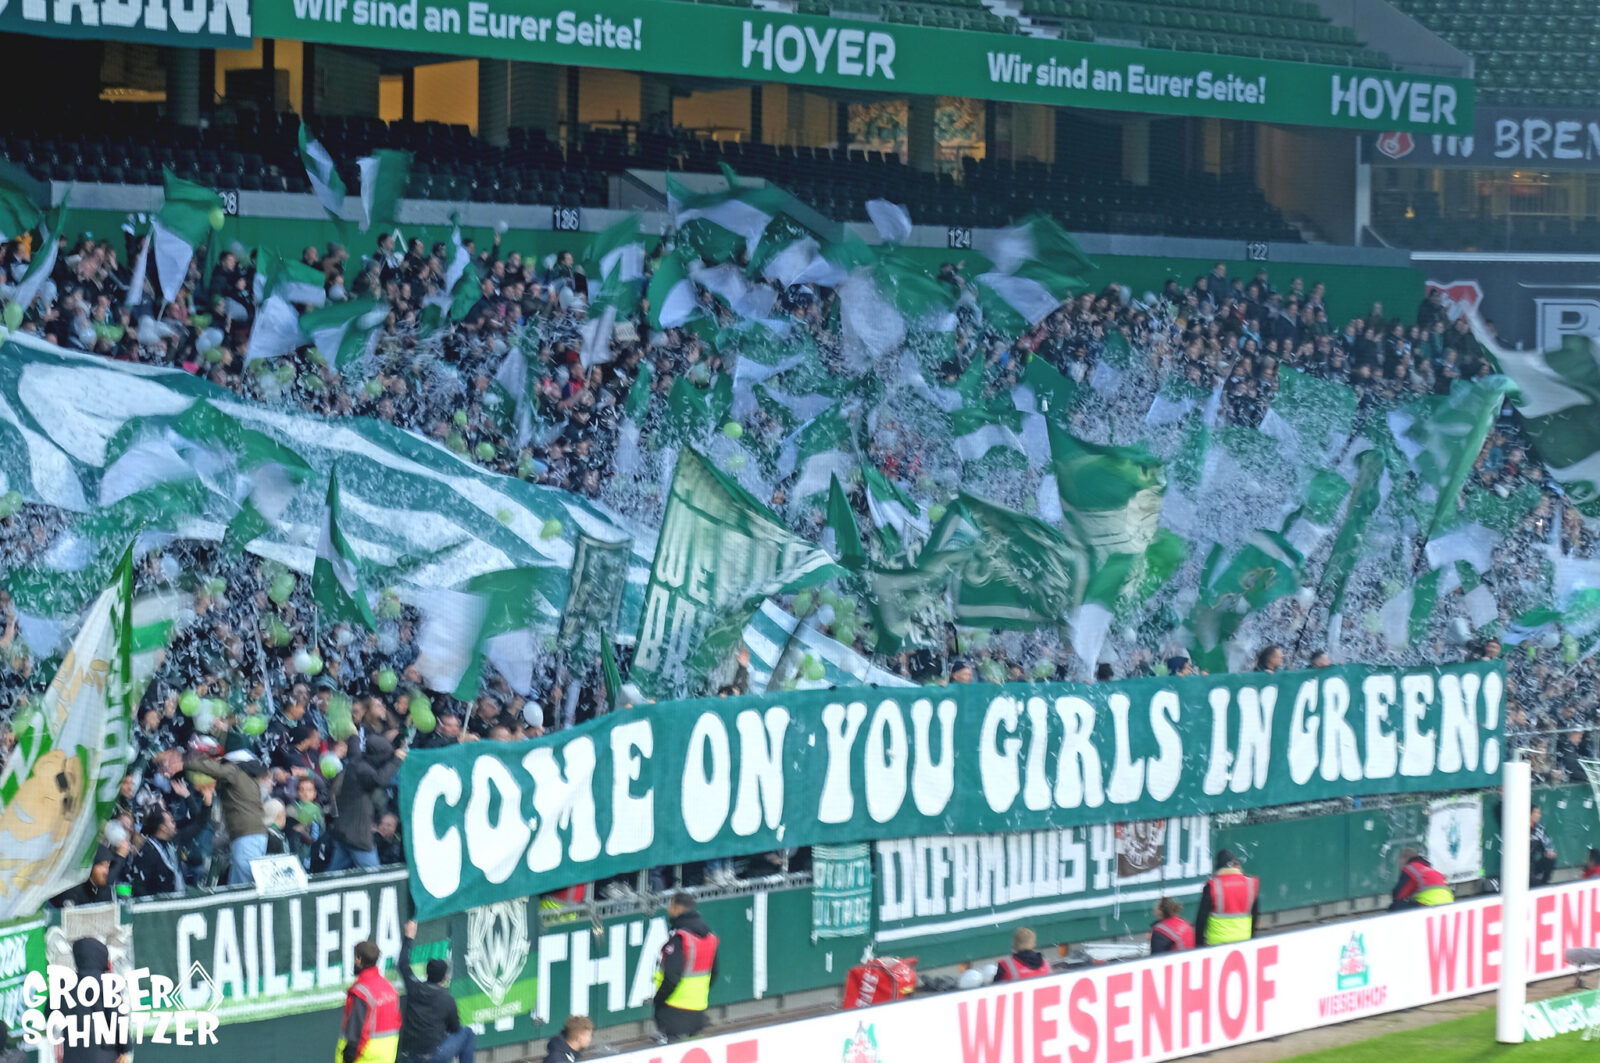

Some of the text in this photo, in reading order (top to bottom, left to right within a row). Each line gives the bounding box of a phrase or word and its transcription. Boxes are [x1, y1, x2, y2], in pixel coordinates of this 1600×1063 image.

[293, 0, 643, 51] Wir sind an Eurer Seite!
[741, 20, 896, 80] HOYER
[987, 52, 1267, 104] Wir sind an Eurer Seite!
[1331, 75, 1458, 125] HOYER
[948, 229, 971, 249] 124
[1248, 243, 1269, 260] 122
[411, 670, 1503, 899] COME ON YOU GIRLS IN GREEN!
[957, 944, 1279, 1063] WIESENHOF
[1317, 985, 1388, 1018] WIESENHOF
